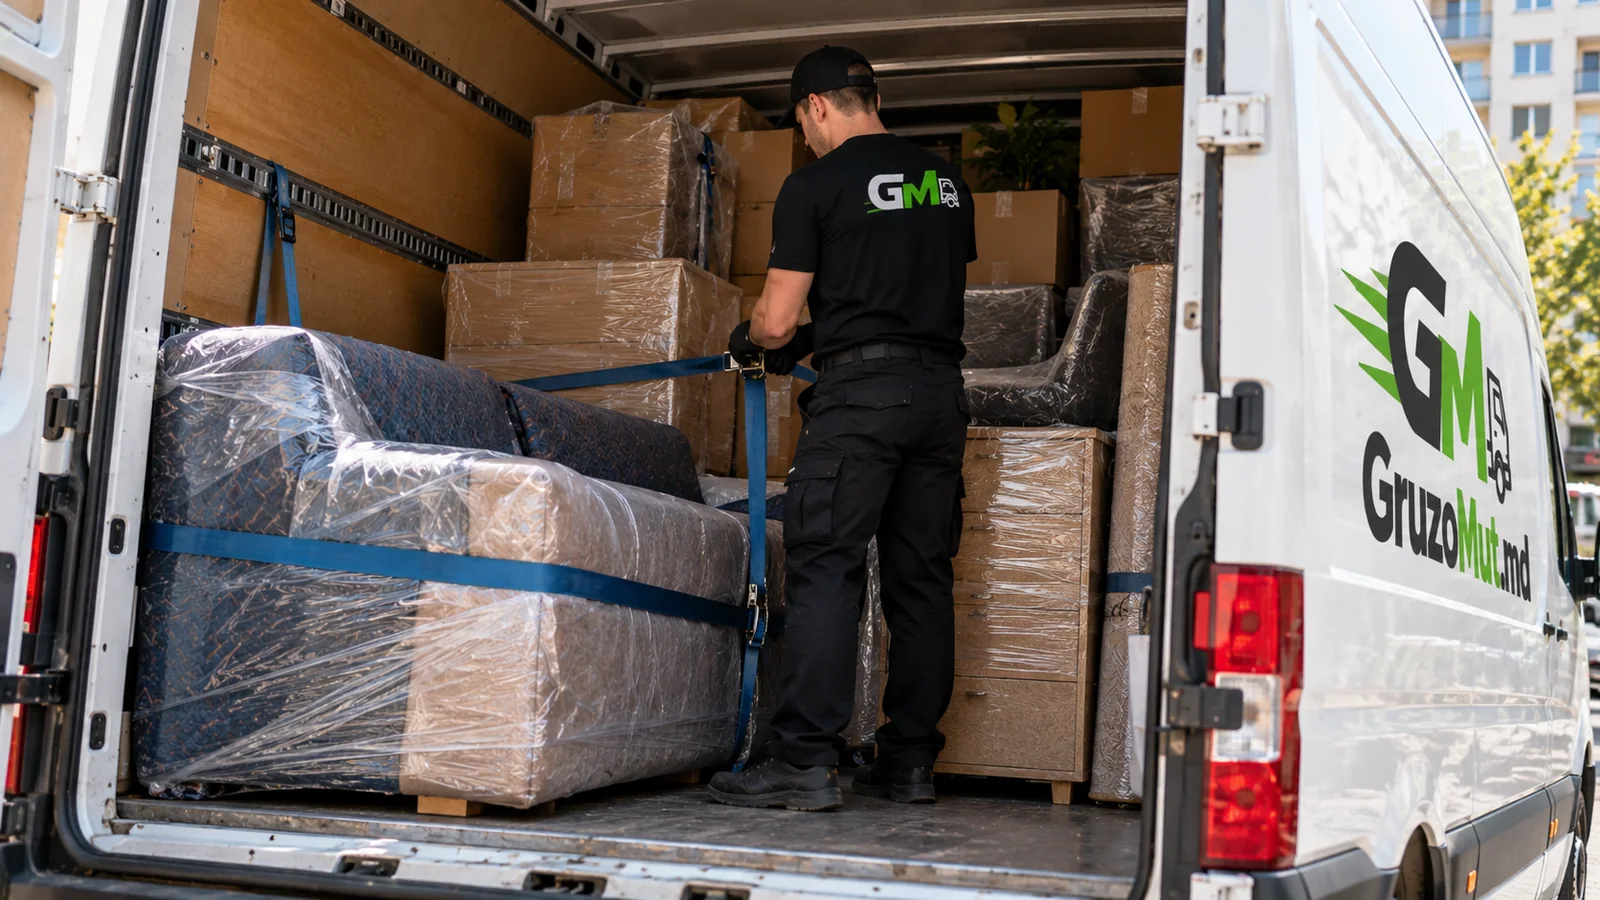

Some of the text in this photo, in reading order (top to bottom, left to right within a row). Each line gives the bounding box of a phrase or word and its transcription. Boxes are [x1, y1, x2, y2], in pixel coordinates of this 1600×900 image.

[868, 170, 940, 210] GM
[1387, 241, 1488, 484] GM
[1363, 431, 1531, 602] GruzoMut.md
